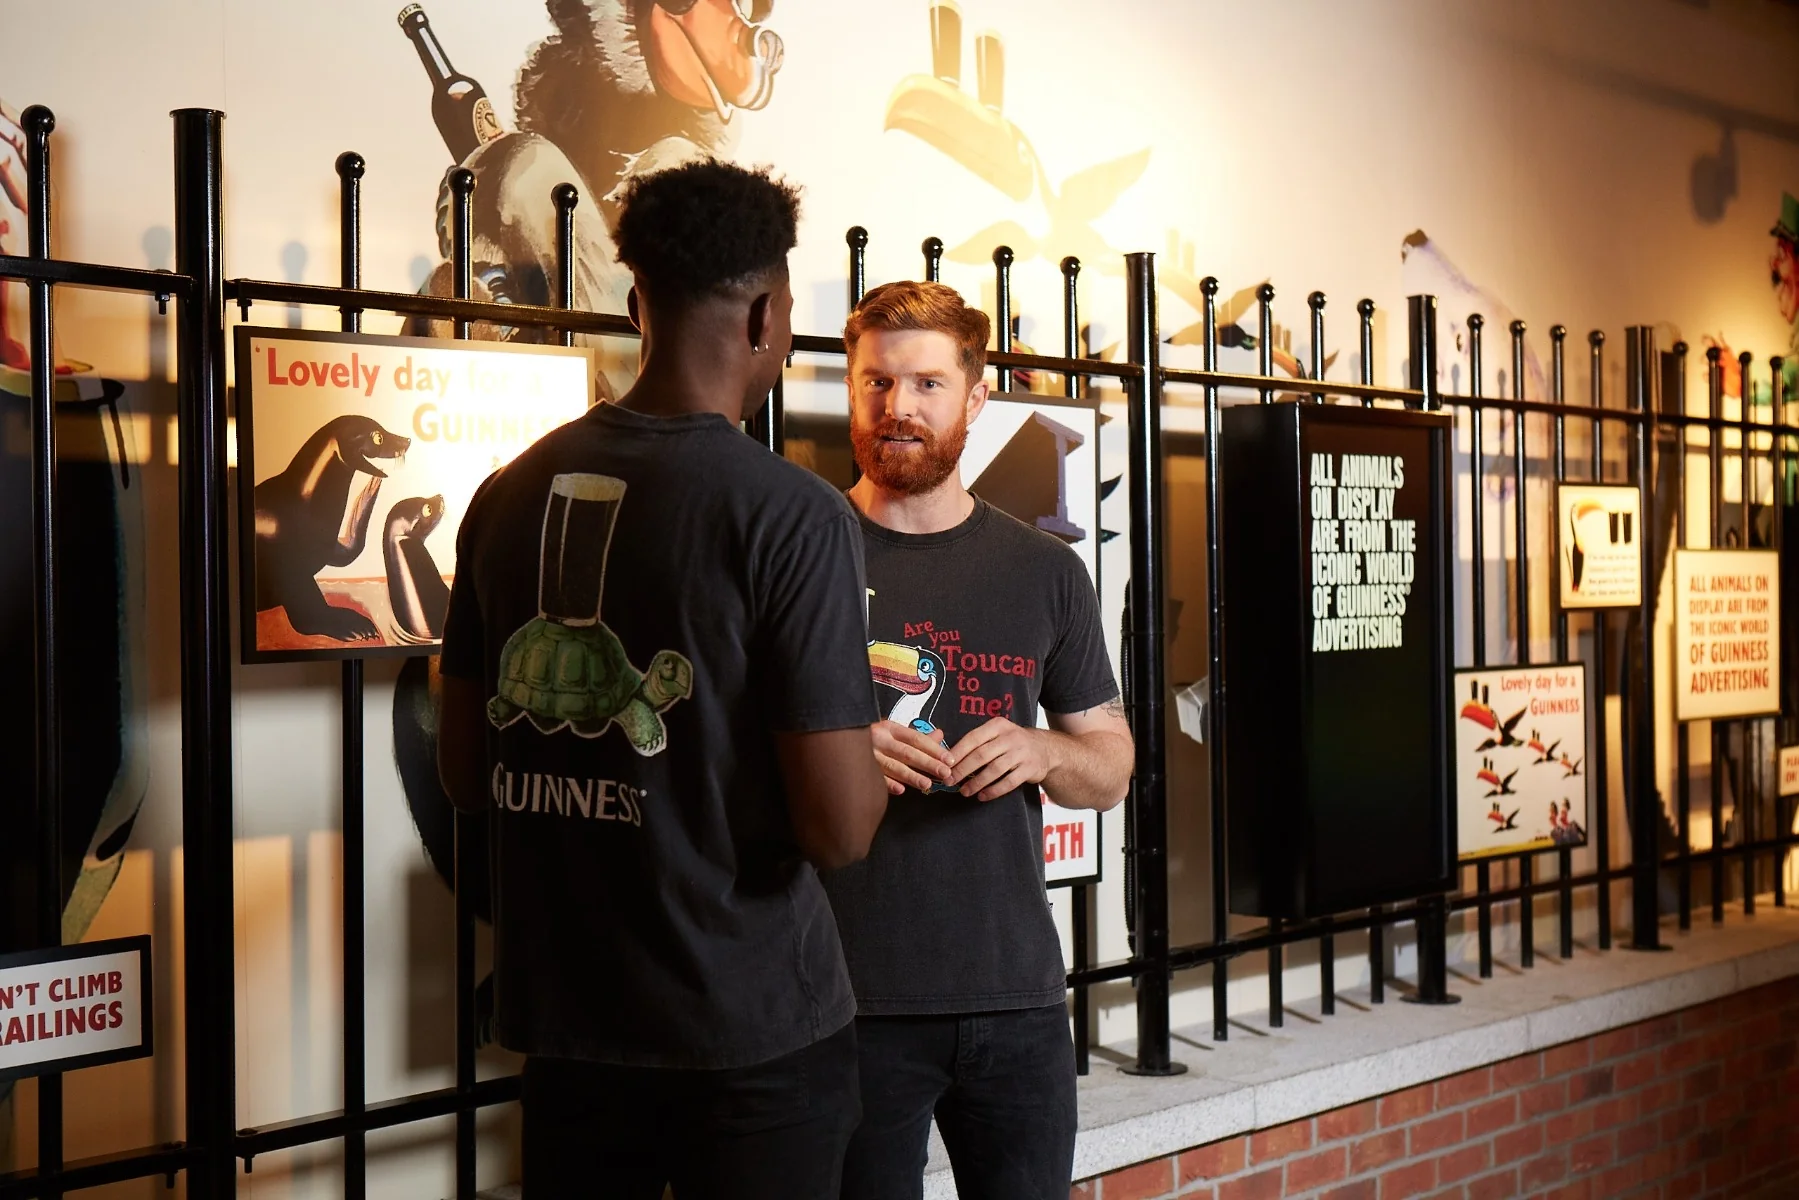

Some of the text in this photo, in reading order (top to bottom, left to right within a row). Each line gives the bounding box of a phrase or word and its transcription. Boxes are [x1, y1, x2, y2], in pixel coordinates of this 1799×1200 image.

[394, 356, 451, 397] day
[1310, 453, 1404, 489] ALL ANIMALS
[1311, 486, 1395, 520] ON DISPLAY
[1311, 519, 1416, 552] ARE FROM THE
[1312, 551, 1415, 585] ICONIC WORLD
[1690, 575, 1769, 592] ALL ANIMALS ON
[1312, 585, 1332, 619] OF
[1690, 597, 1769, 614] DISPLAY ARE FROM
[904, 621, 934, 638] Are
[929, 629, 960, 649] you
[1313, 616, 1402, 652] ADVERTISING
[1690, 619, 1769, 637] THE ICONIC WORLD
[939, 645, 1036, 679] Toucan
[1690, 640, 1769, 664] OF GUINNESS
[957, 672, 980, 692] to
[1501, 672, 1576, 694] Lovely day for a
[1691, 667, 1769, 694] ADVERTISING
[959, 693, 1013, 719] me?
[1530, 698, 1580, 716] GUINNESS
[48, 970, 123, 1003] CLIMB
[0, 1000, 123, 1046] AILINGS
